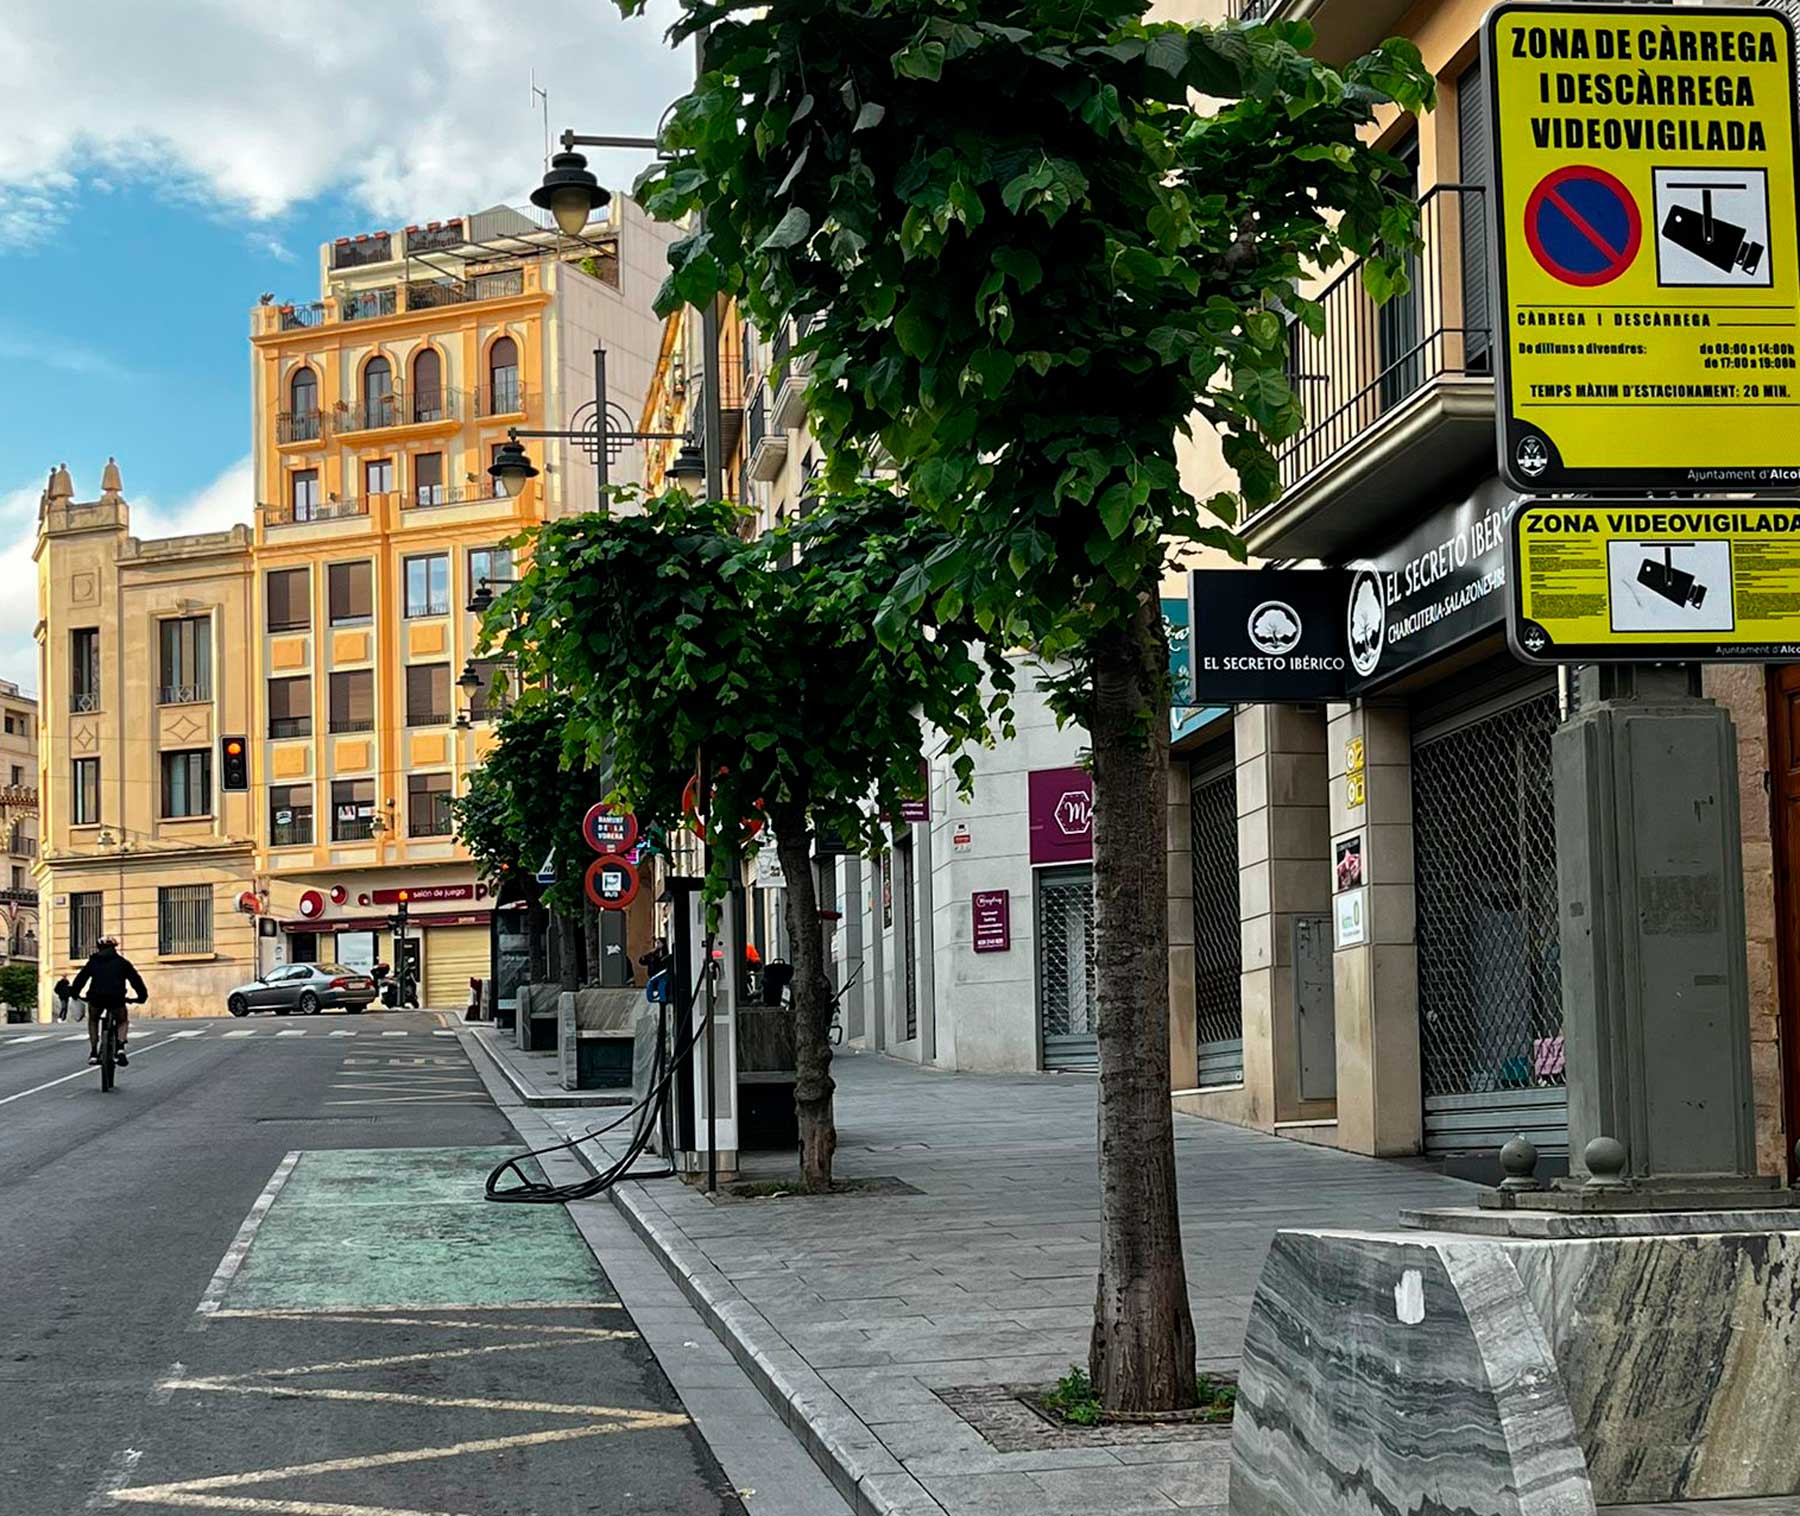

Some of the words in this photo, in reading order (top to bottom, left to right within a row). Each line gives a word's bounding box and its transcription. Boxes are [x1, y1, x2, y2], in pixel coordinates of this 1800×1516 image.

[1511, 27, 1590, 59] ZONA
[1595, 29, 1632, 60] DE
[1638, 25, 1777, 62] CÀRREGA
[1540, 73, 1549, 103] I
[1556, 69, 1755, 107] DESCÀRREGA
[1531, 118, 1767, 151] VIDEOVIGILADA
[1517, 310, 1585, 326] CÀRREGA
[1597, 312, 1602, 326] I
[1614, 311, 1710, 327] DESCÀRREGA
[1519, 342, 1533, 354] De
[1535, 342, 1575, 354] dilluns
[1577, 344, 1584, 354] a
[1586, 342, 1647, 354] divendres:
[1700, 343, 1713, 354] de
[1716, 343, 1747, 354] 08:00
[1749, 345, 1756, 354] a
[1758, 343, 1794, 354] 14:00h
[1704, 357, 1718, 368] de
[1720, 357, 1748, 368] 17:00
[1750, 359, 1757, 368] a
[1530, 384, 1571, 398] TEMPS
[1576, 382, 1618, 398] MÀXIM
[1623, 384, 1739, 398] D'ESTACIONAMENT:
[1743, 385, 1759, 398] 20
[1763, 385, 1791, 398] MIN.
[1688, 469, 1756, 482] Ajuntament
[1527, 514, 1600, 533] ZONA
[1607, 514, 1800, 533] VIDEOVIGILADA
[1386, 571, 1402, 607] EL
[1405, 532, 1468, 597] SECRETO
[1715, 646, 1770, 656] Ajuntament
[1204, 657, 1219, 670] EL
[1223, 657, 1286, 670] SECRETO
[1290, 654, 1345, 670] IBÉRICO
[433, 889, 443, 897] de
[444, 888, 466, 898] juego
